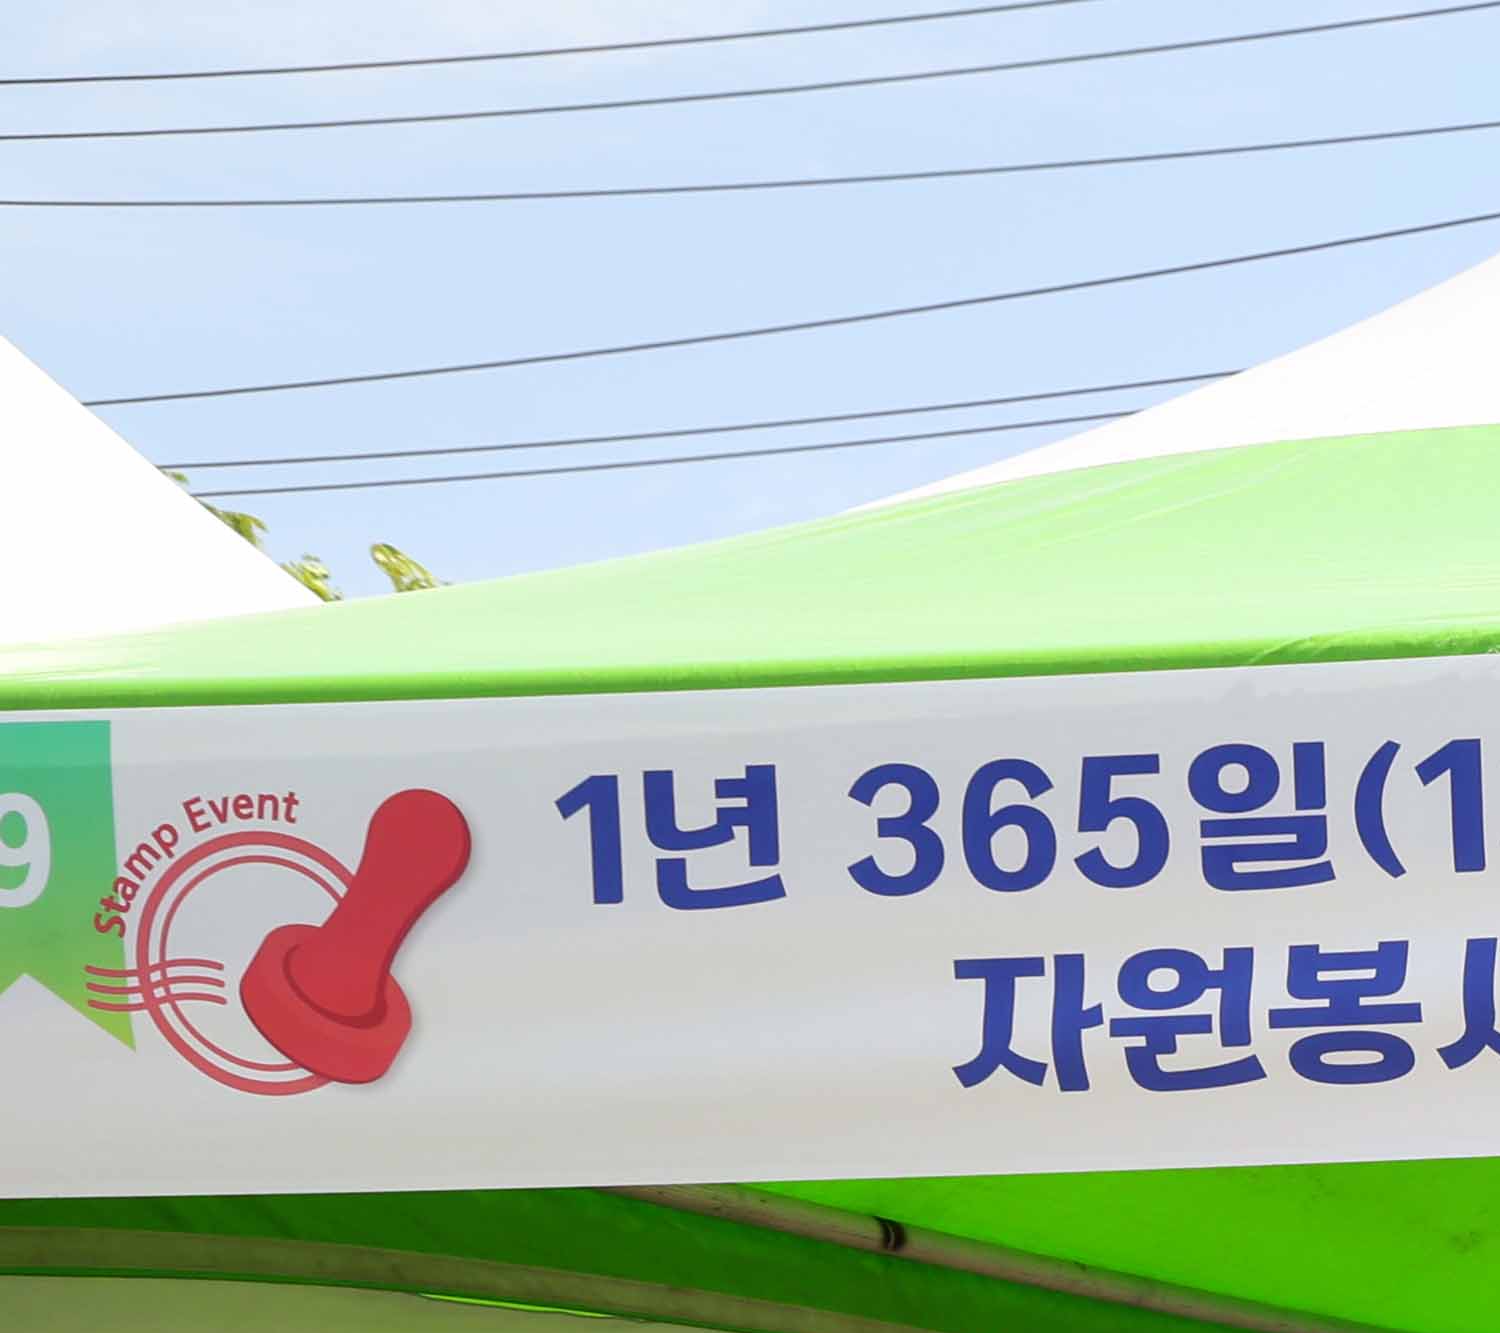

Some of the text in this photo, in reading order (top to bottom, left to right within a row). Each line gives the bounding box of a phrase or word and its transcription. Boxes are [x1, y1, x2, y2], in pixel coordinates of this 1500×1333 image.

[93, 790, 300, 939] Stamp Event
[557, 764, 786, 910] 1년
